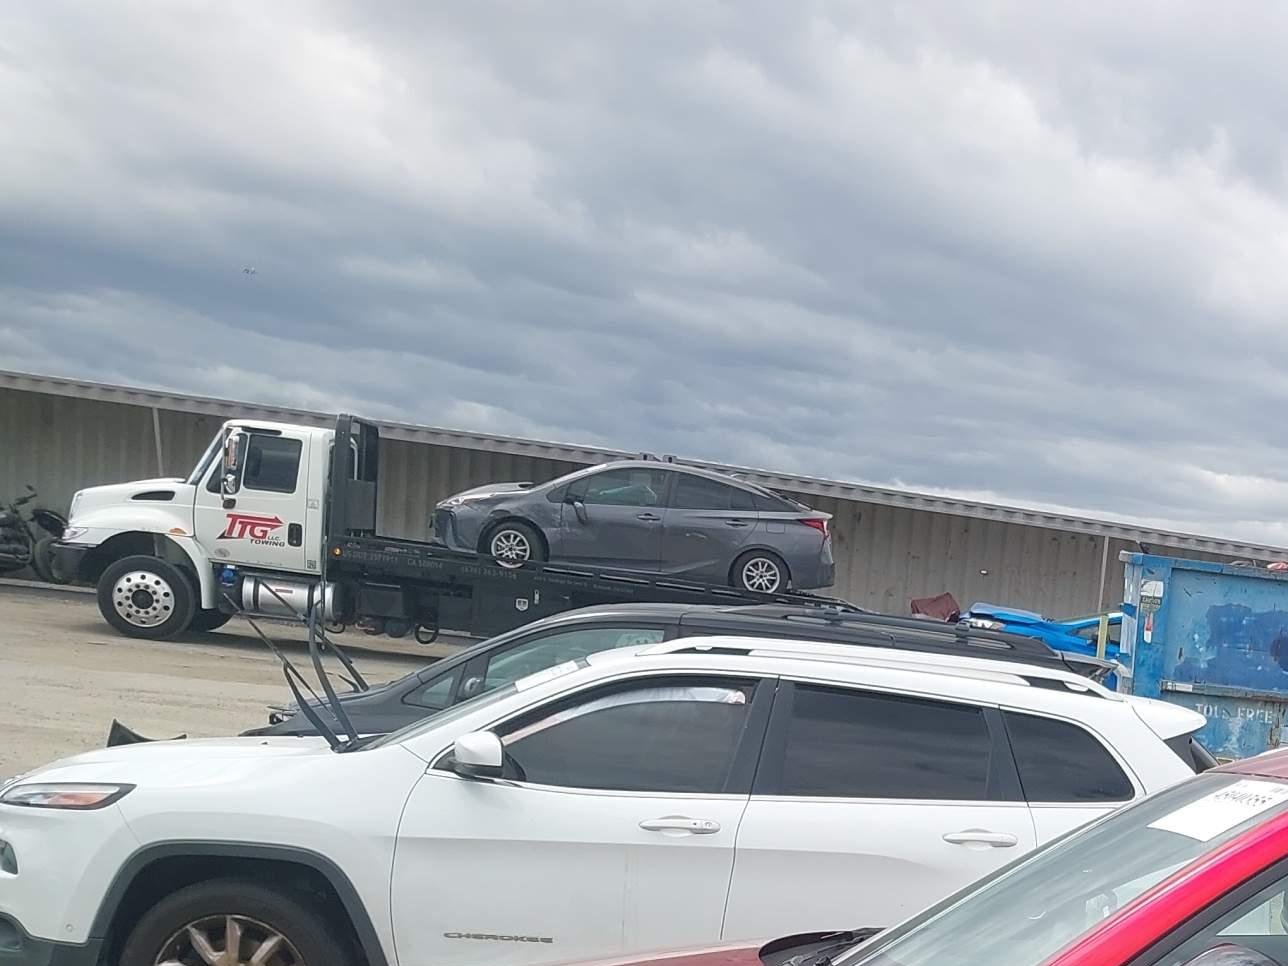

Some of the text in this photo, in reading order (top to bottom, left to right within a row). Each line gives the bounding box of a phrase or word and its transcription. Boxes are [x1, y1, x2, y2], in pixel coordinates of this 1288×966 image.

[250, 539, 286, 548] TOWING
[1237, 707, 1273, 724] FREE
[443, 932, 553, 944] CHEROKEE
